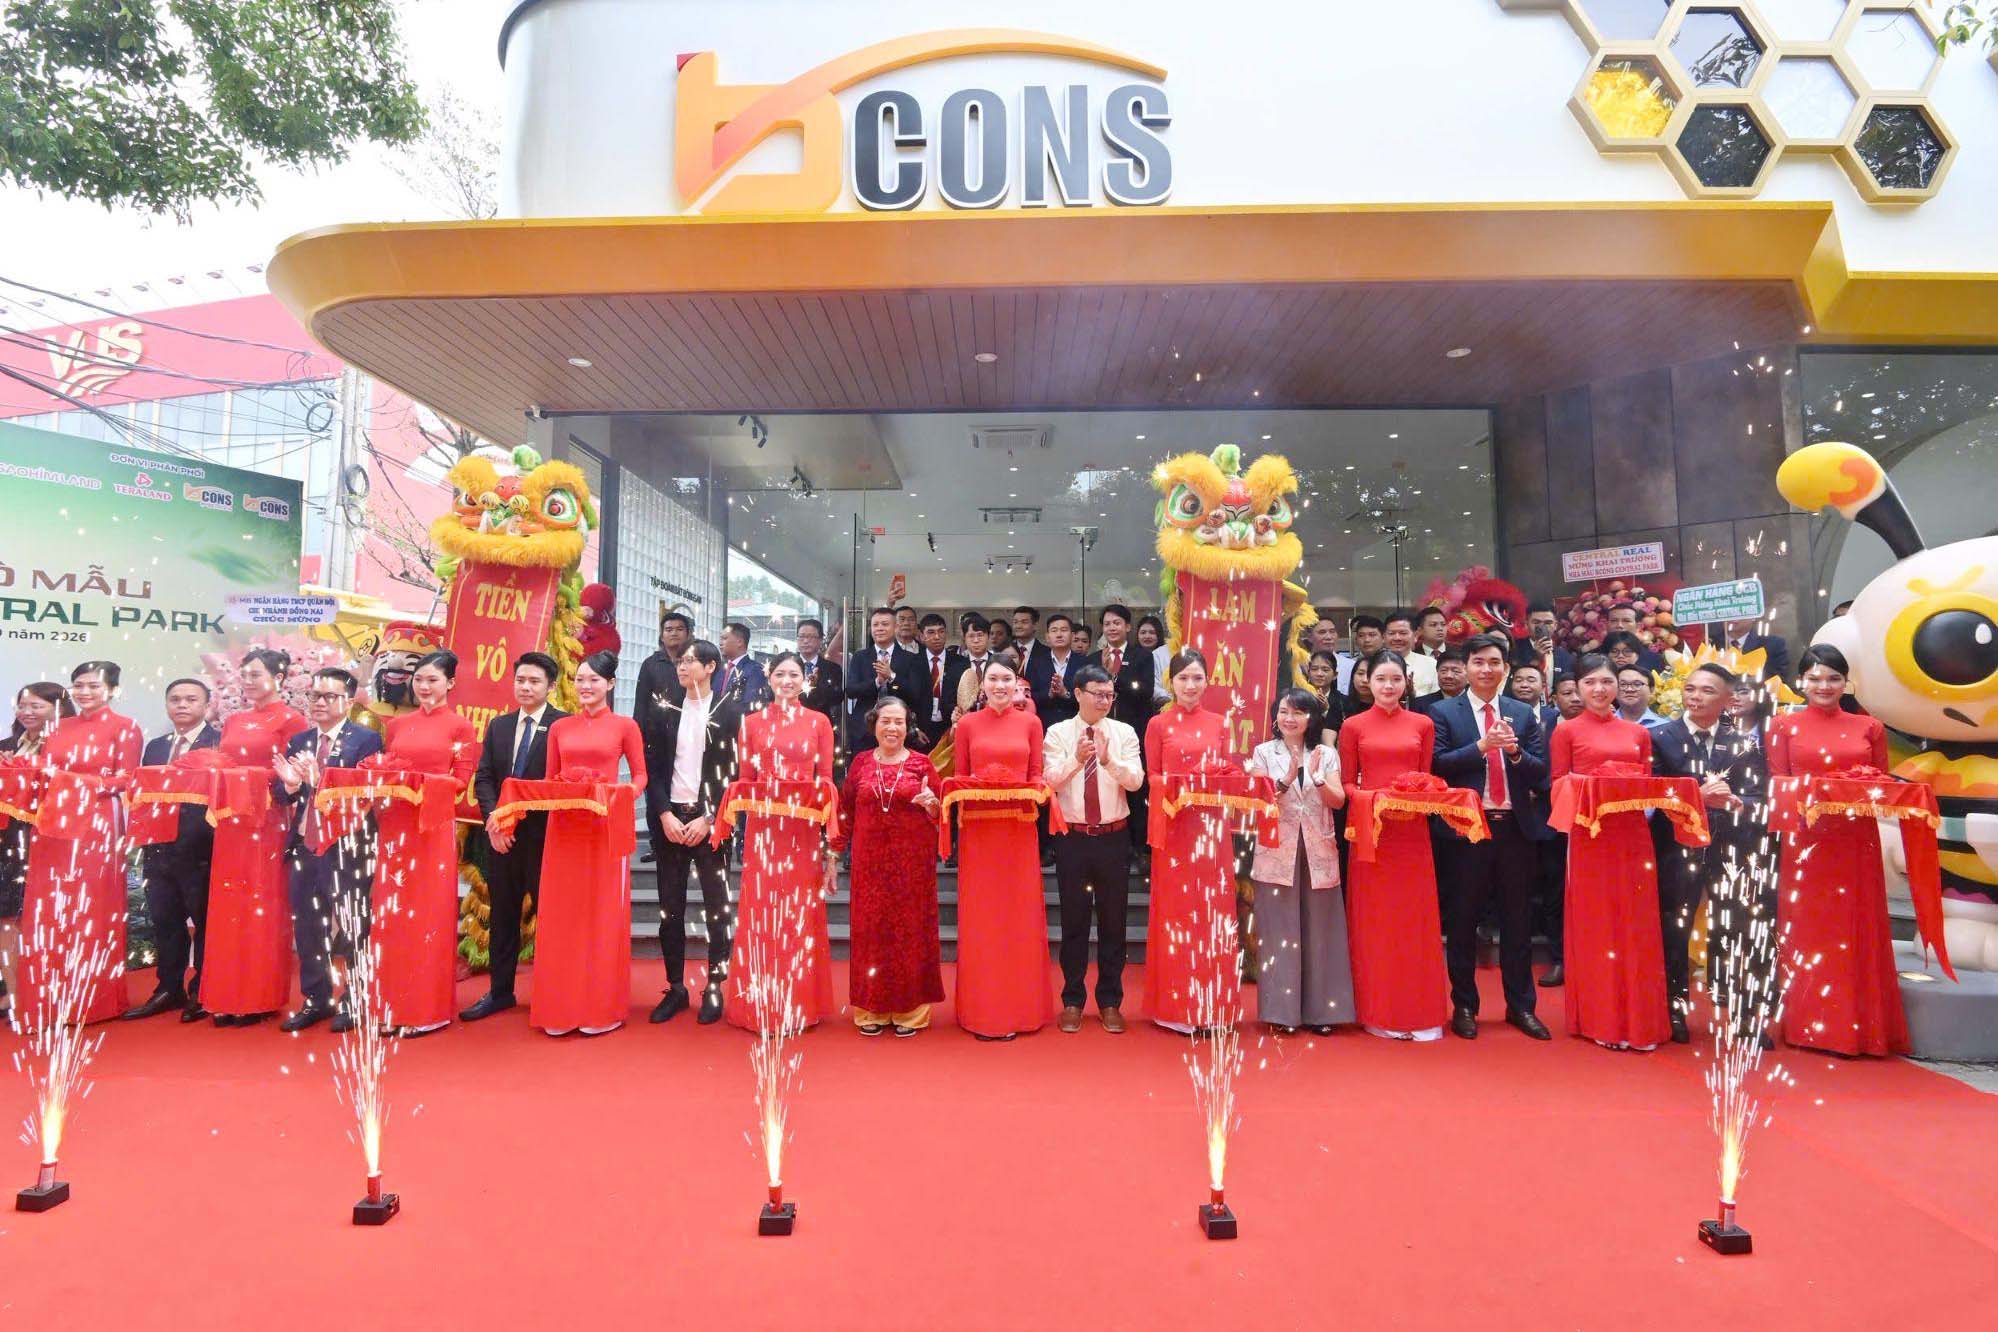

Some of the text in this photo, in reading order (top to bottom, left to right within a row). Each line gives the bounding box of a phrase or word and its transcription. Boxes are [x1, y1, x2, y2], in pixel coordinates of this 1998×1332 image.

[116, 485, 171, 500] TERALAND
[1623, 547, 1652, 556] REAL
[32, 564, 151, 599] MẪU
[0, 596, 225, 634] RAL PARK
[9, 629, 44, 640] năm
[476, 636, 507, 682] VÔ
[1209, 640, 1246, 688] ĂN
